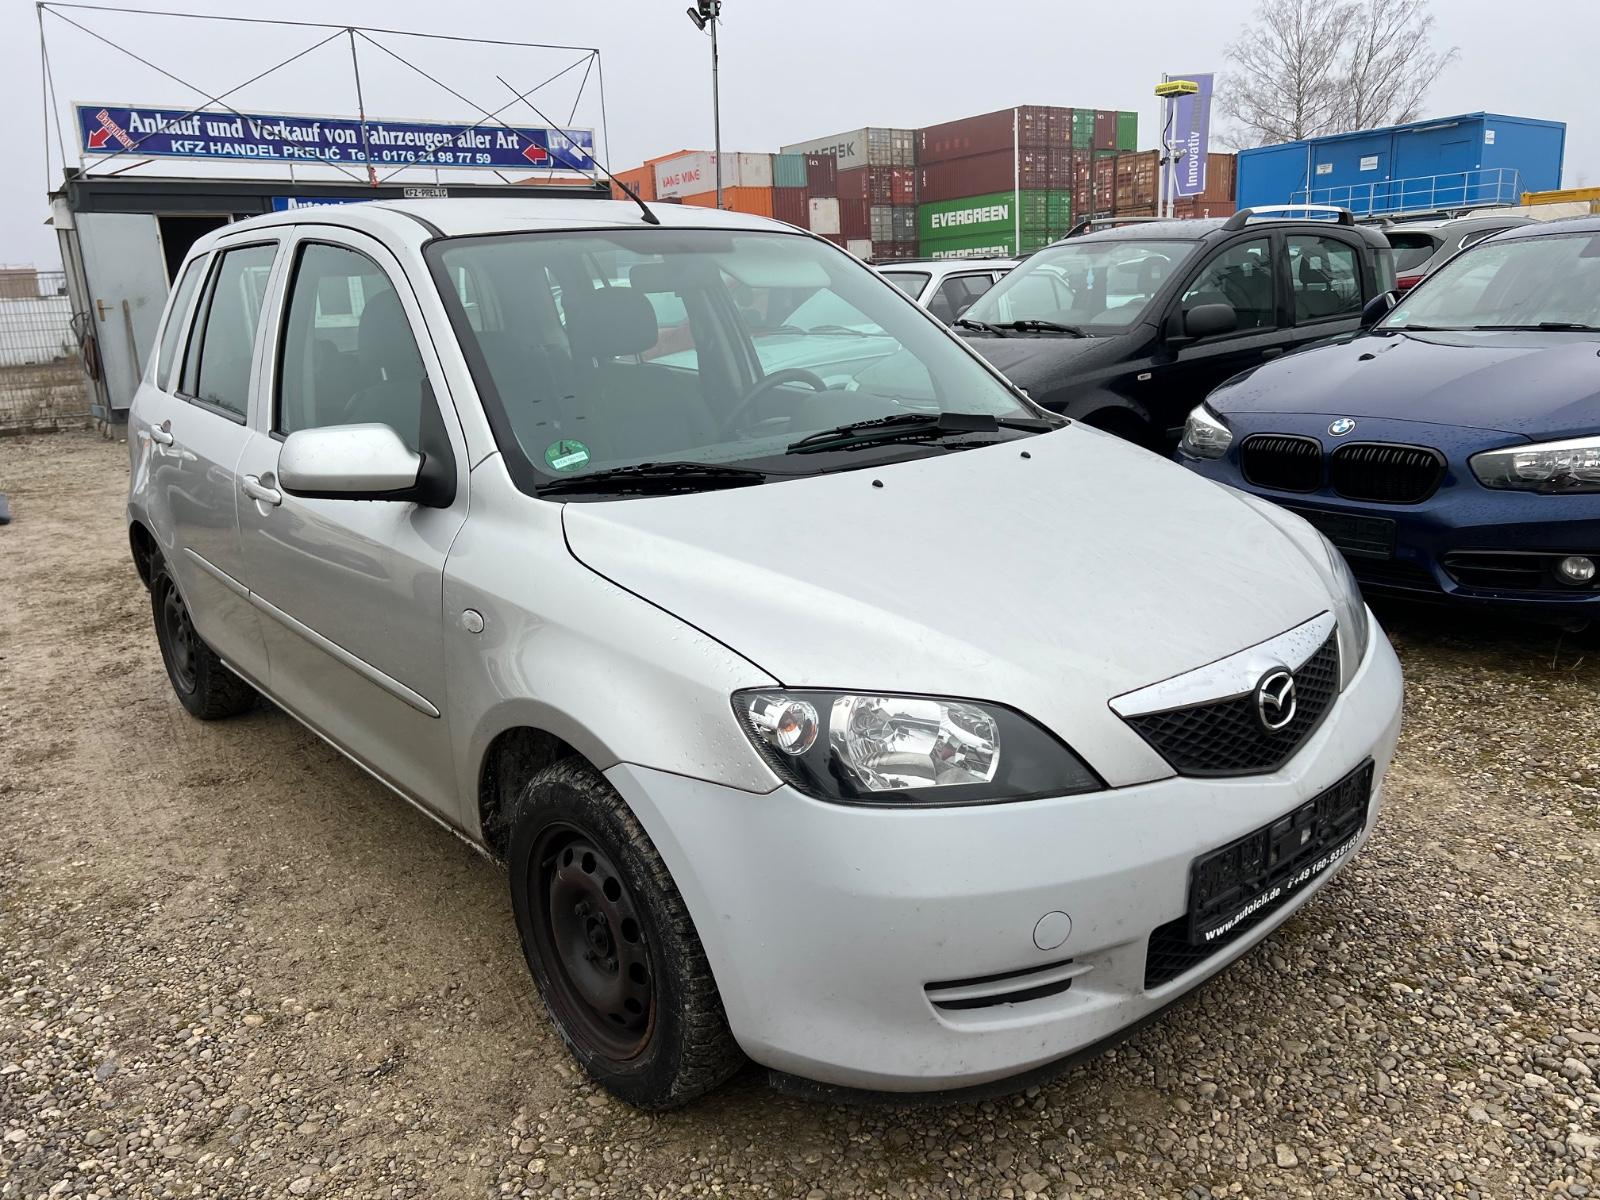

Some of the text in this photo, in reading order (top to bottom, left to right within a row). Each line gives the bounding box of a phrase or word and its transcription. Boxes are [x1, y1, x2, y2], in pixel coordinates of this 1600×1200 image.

[129, 111, 201, 136] Ankauf
[205, 118, 245, 138] und
[247, 119, 320, 142] Verkauf
[323, 128, 357, 144] von
[457, 129, 492, 149] aller
[496, 130, 520, 149] Art
[171, 140, 206, 154] KFZ
[209, 142, 280, 157] HANDEL
[283, 145, 341, 159] PRELIĆ
[382, 150, 416, 162] 0176
[418, 151, 435, 163] 24
[437, 152, 454, 163] 98
[456, 152, 472, 163] 77
[475, 153, 491, 164] 59
[931, 204, 1009, 229] EVERGREEN
[1205, 887, 1281, 941] www.autoicli.de
